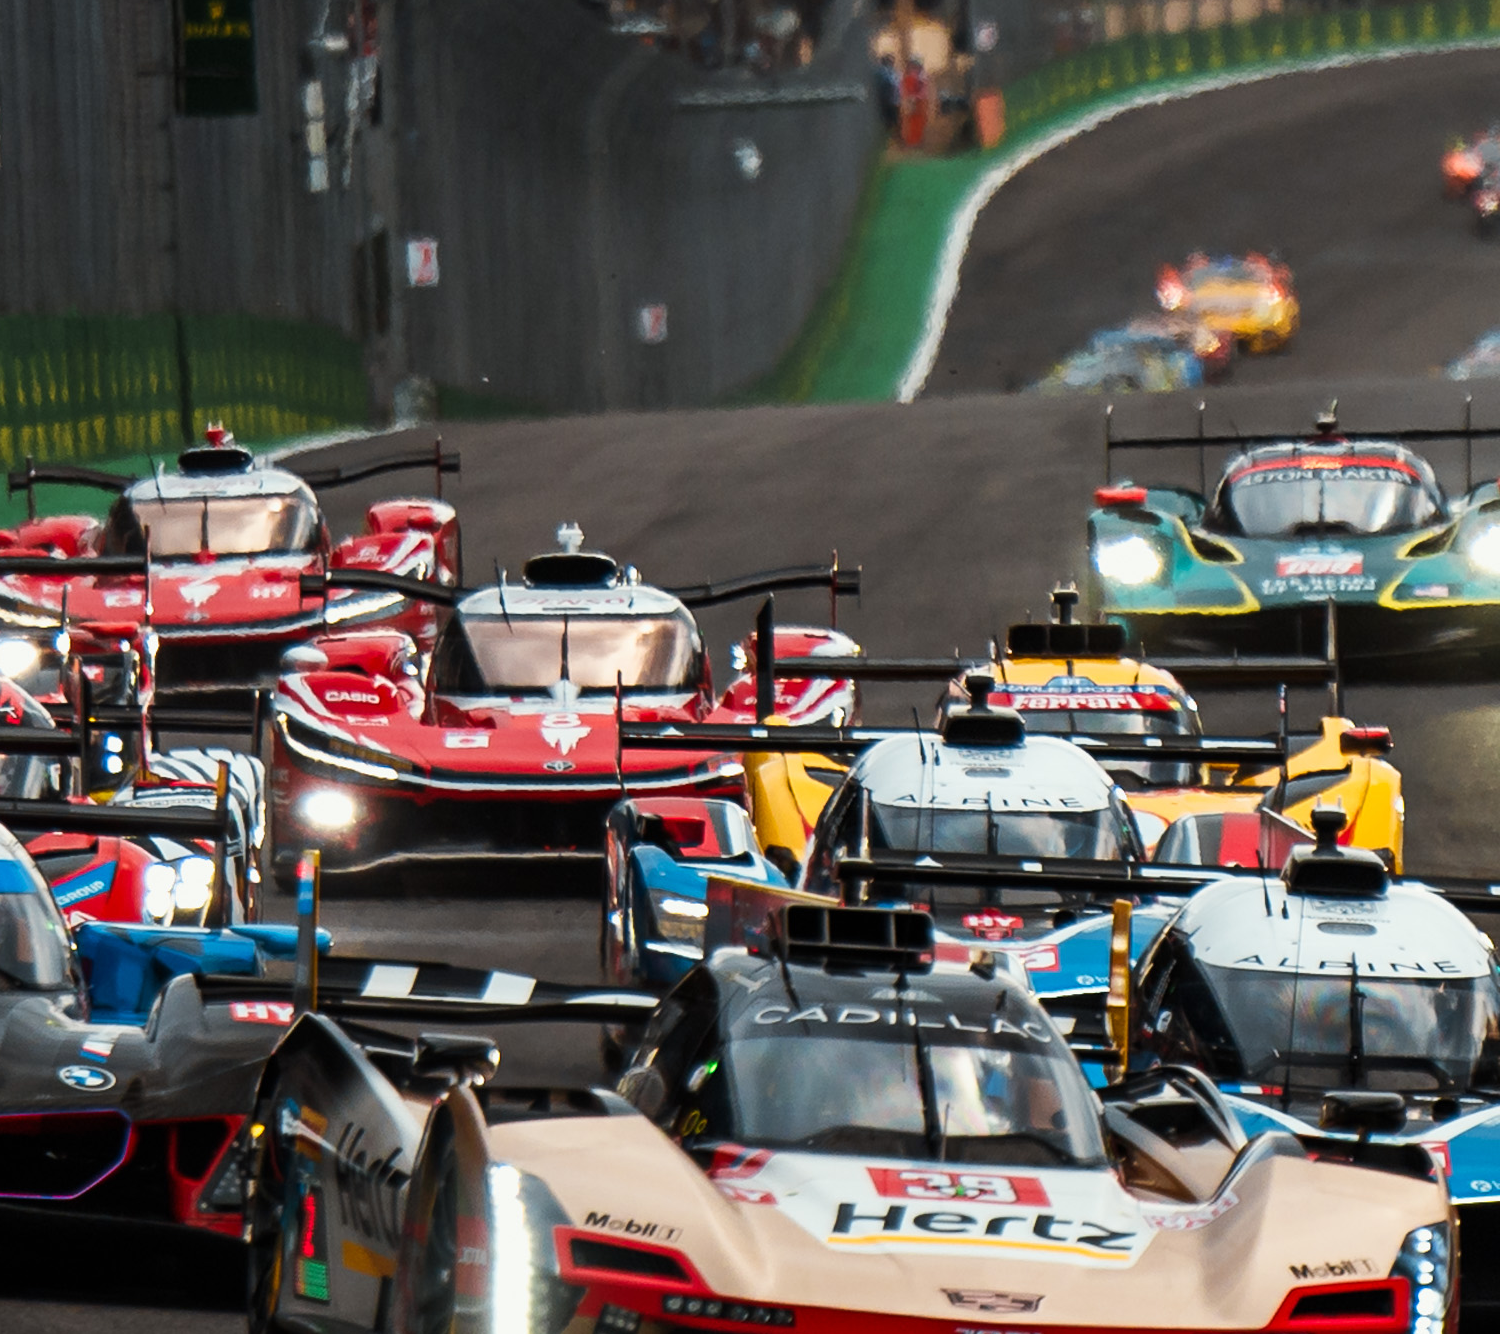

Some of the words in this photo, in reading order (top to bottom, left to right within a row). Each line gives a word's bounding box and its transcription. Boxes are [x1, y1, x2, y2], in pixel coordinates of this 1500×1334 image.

[324, 689, 381, 705] CASIO
[1234, 953, 1463, 974] ALPINE
[752, 1004, 1053, 1045] CADILLAC
[900, 1170, 1019, 1205] 38
[583, 1211, 659, 1238] Mobil
[831, 1202, 1140, 1252] Hertz
[1289, 1260, 1358, 1280] Mobil
